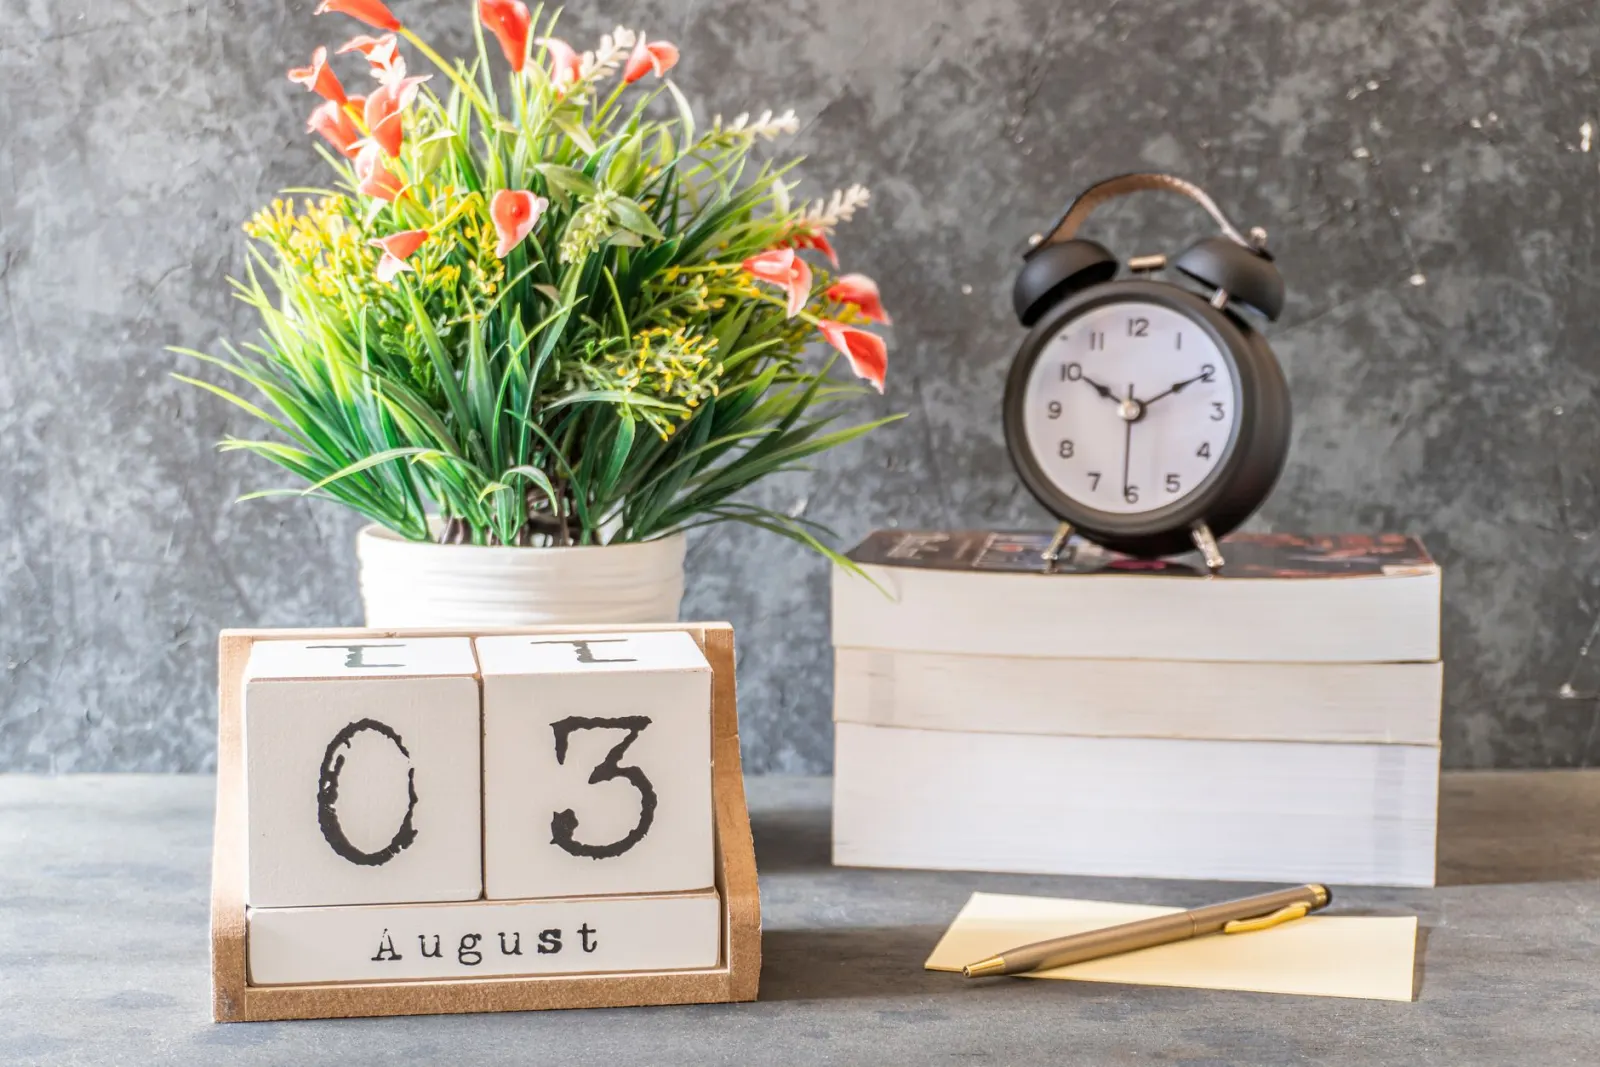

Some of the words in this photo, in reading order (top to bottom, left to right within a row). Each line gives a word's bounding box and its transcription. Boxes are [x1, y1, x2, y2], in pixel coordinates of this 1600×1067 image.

[1126, 318, 1150, 338] 12
[1089, 332, 1105, 351] 11
[1176, 332, 1182, 351] 1
[1060, 363, 1083, 382] 10
[1200, 364, 1216, 383] 2
[1048, 401, 1062, 419] 9
[1210, 402, 1226, 421] 3
[1059, 439, 1075, 459] 8
[1196, 442, 1211, 460] 4
[1086, 472, 1102, 492] 7
[1165, 473, 1181, 493] 5
[1125, 486, 1139, 504] 6
[371, 922, 598, 966] August
